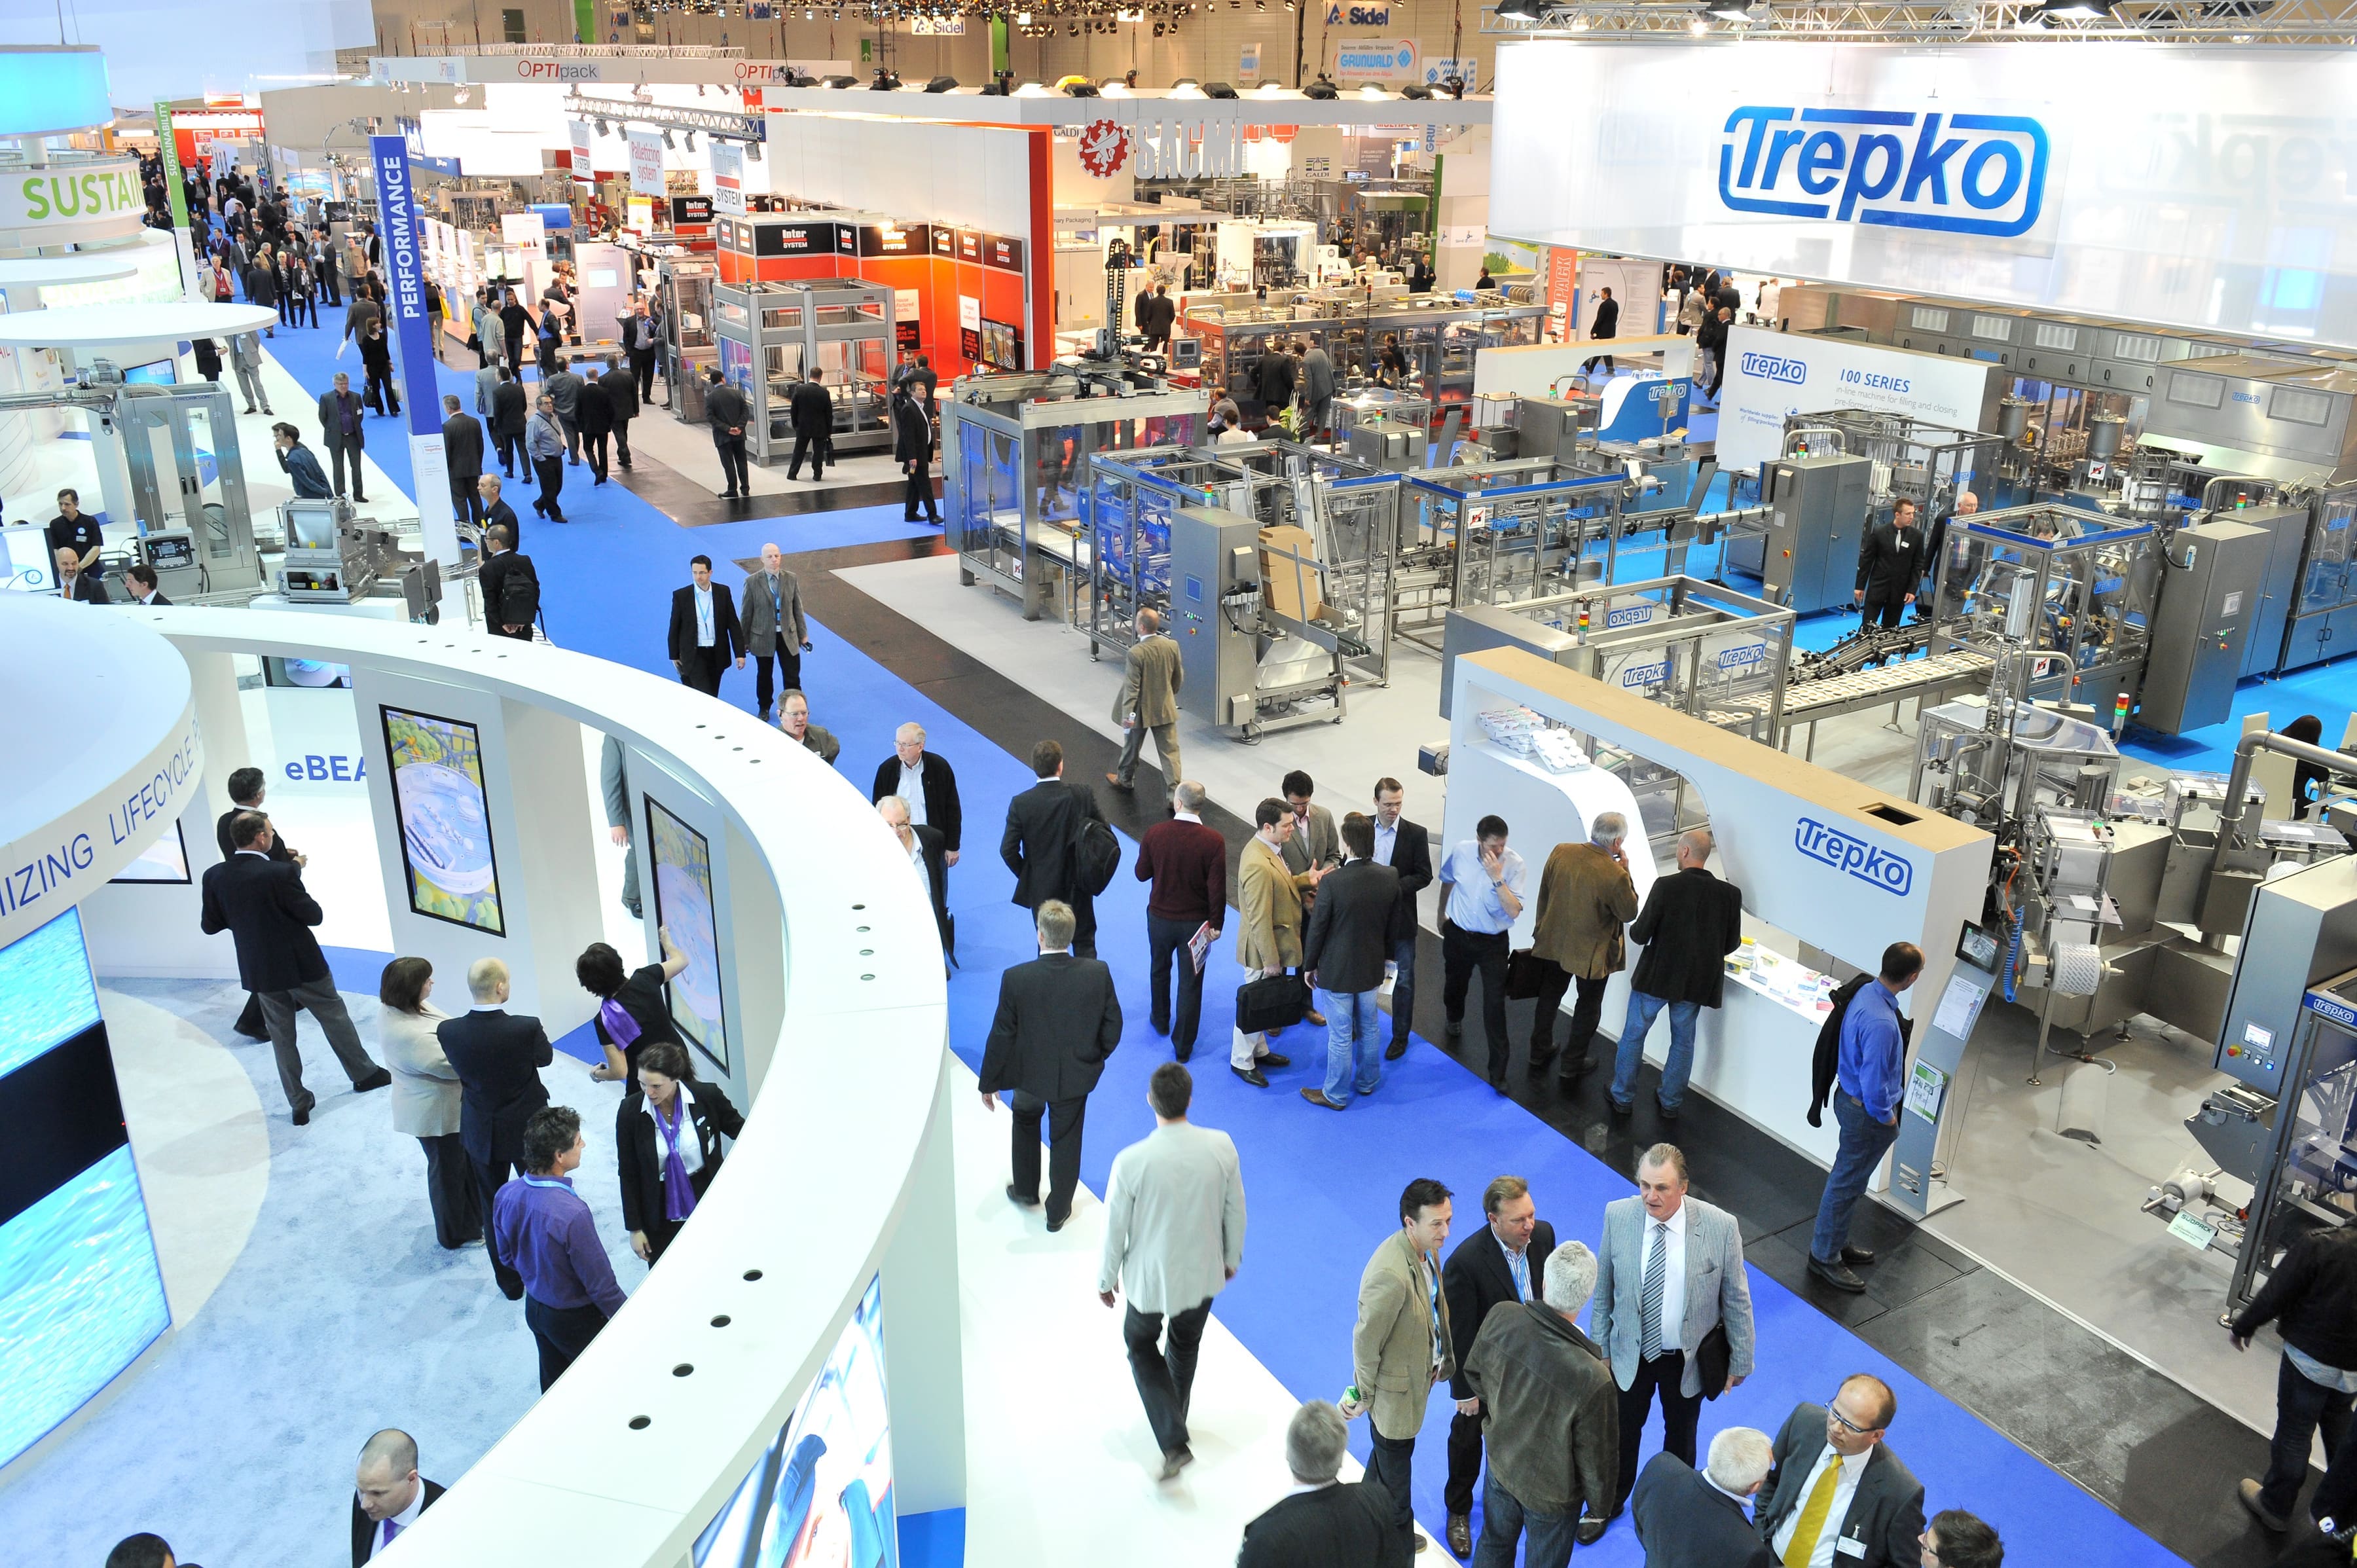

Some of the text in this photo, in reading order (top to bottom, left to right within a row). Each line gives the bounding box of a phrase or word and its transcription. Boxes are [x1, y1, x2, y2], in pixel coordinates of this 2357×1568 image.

[934, 21, 964, 33] Sidel
[1349, 7, 1389, 26] Sidel
[518, 60, 597, 81] OPTIpack
[1340, 54, 1393, 68] GRUNWALD
[158, 103, 177, 177] SUSTAINABILITY
[1135, 118, 1243, 179] SACMI
[631, 141, 660, 168] Palletizing
[1728, 105, 2026, 223] Trepko
[637, 164, 657, 184] system
[686, 201, 708, 210] Inter
[716, 187, 742, 207] SYSTEM
[384, 156, 420, 318] PERFORMANCE
[782, 229, 807, 238] Inter
[1742, 352, 1804, 380] Trepko
[1648, 383, 1686, 401] Treko
[1840, 368, 1910, 393] 100 SERIES
[1836, 386, 1857, 396] in-line
[1857, 389, 1886, 402] machine
[1887, 393, 1897, 404] for
[1899, 395, 1917, 410] filling
[1918, 399, 1932, 410] and
[1933, 403, 1958, 419] closing
[2233, 392, 2260, 403] Trepko
[1739, 408, 1779, 420] Worldwide supplier
[1719, 644, 1764, 668] Trepko
[1624, 661, 1672, 687] Trepko
[0, 735, 194, 918] IZING LIFECYCLE
[1798, 818, 1907, 889] Trepko
[2314, 998, 2353, 1022] Trepko
